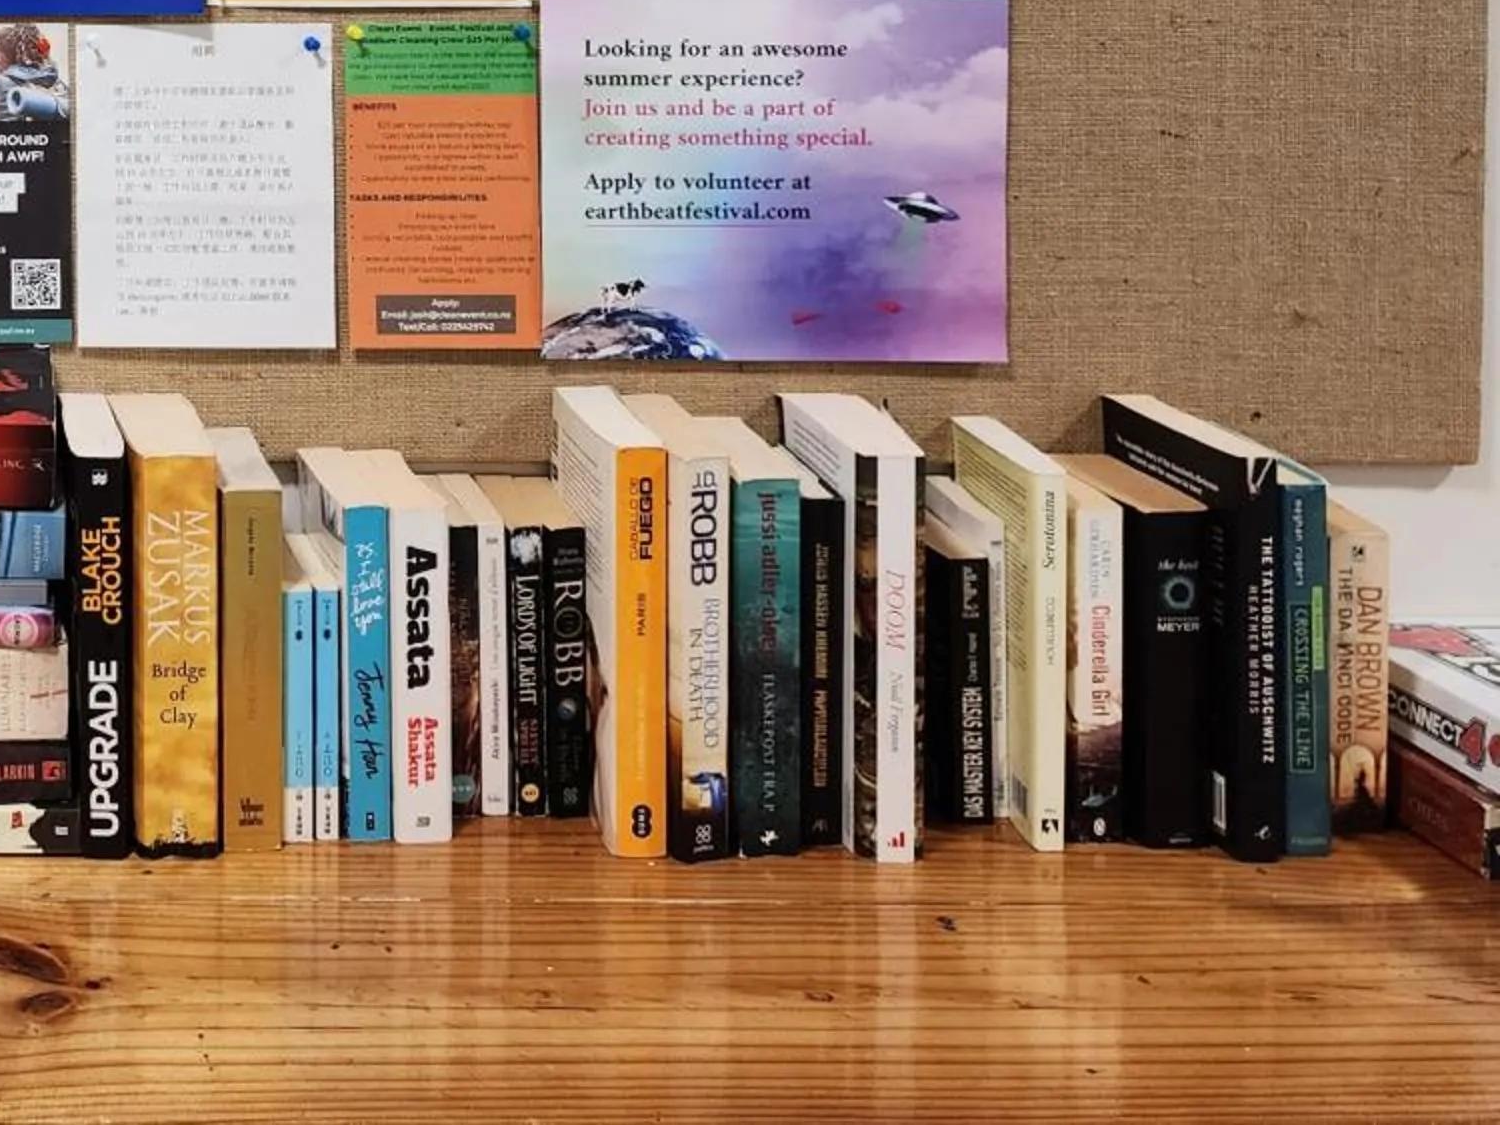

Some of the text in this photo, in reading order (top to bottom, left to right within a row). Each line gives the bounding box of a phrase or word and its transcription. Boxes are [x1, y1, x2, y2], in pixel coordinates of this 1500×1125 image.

[6, 150, 44, 162] AWF!
[584, 173, 811, 194] Apply to volunteer at
[585, 202, 811, 221] earthbeatfestival.com
[640, 477, 653, 560] FUEGO
[691, 491, 717, 587] ROBB
[757, 491, 781, 541] jussi
[1041, 490, 1057, 570] Serotonina
[82, 528, 102, 613] BLAKE
[102, 516, 120, 625] CROUCH
[147, 512, 180, 647] ZUSAK
[184, 509, 211, 645] MARKUS
[884, 570, 907, 651] DOOM
[1338, 568, 1353, 607] THE
[406, 545, 437, 689] Assata
[515, 574, 540, 705] LORDS OF LIGHT
[553, 580, 584, 687] ROBB
[1157, 622, 1200, 632] MEYER
[1248, 585, 1259, 715] HEATHER MORRIS
[1261, 536, 1274, 764] THE TATTOOIST OF AUSCHWITZ
[1338, 608, 1353, 633] DA
[1356, 585, 1382, 731] DAN BROWN
[152, 663, 206, 683] Bridge
[170, 685, 187, 701] of
[689, 628, 702, 723] IN DEATH
[704, 598, 720, 748] BROTHERHOOD
[1091, 605, 1110, 717] Cinderella Girl
[1294, 608, 1310, 766] CROSSING THE LINE
[90, 660, 118, 838] UPGRADE
[159, 707, 197, 729] Clay
[357, 661, 386, 779] Jenny Han
[408, 715, 423, 791] Shakur
[425, 715, 439, 782] Assata
[962, 686, 984, 818] DAS MASTER KEY SYSTEM
[1337, 694, 1353, 744] CODE
[1388, 689, 1486, 771] CONNECT 4
